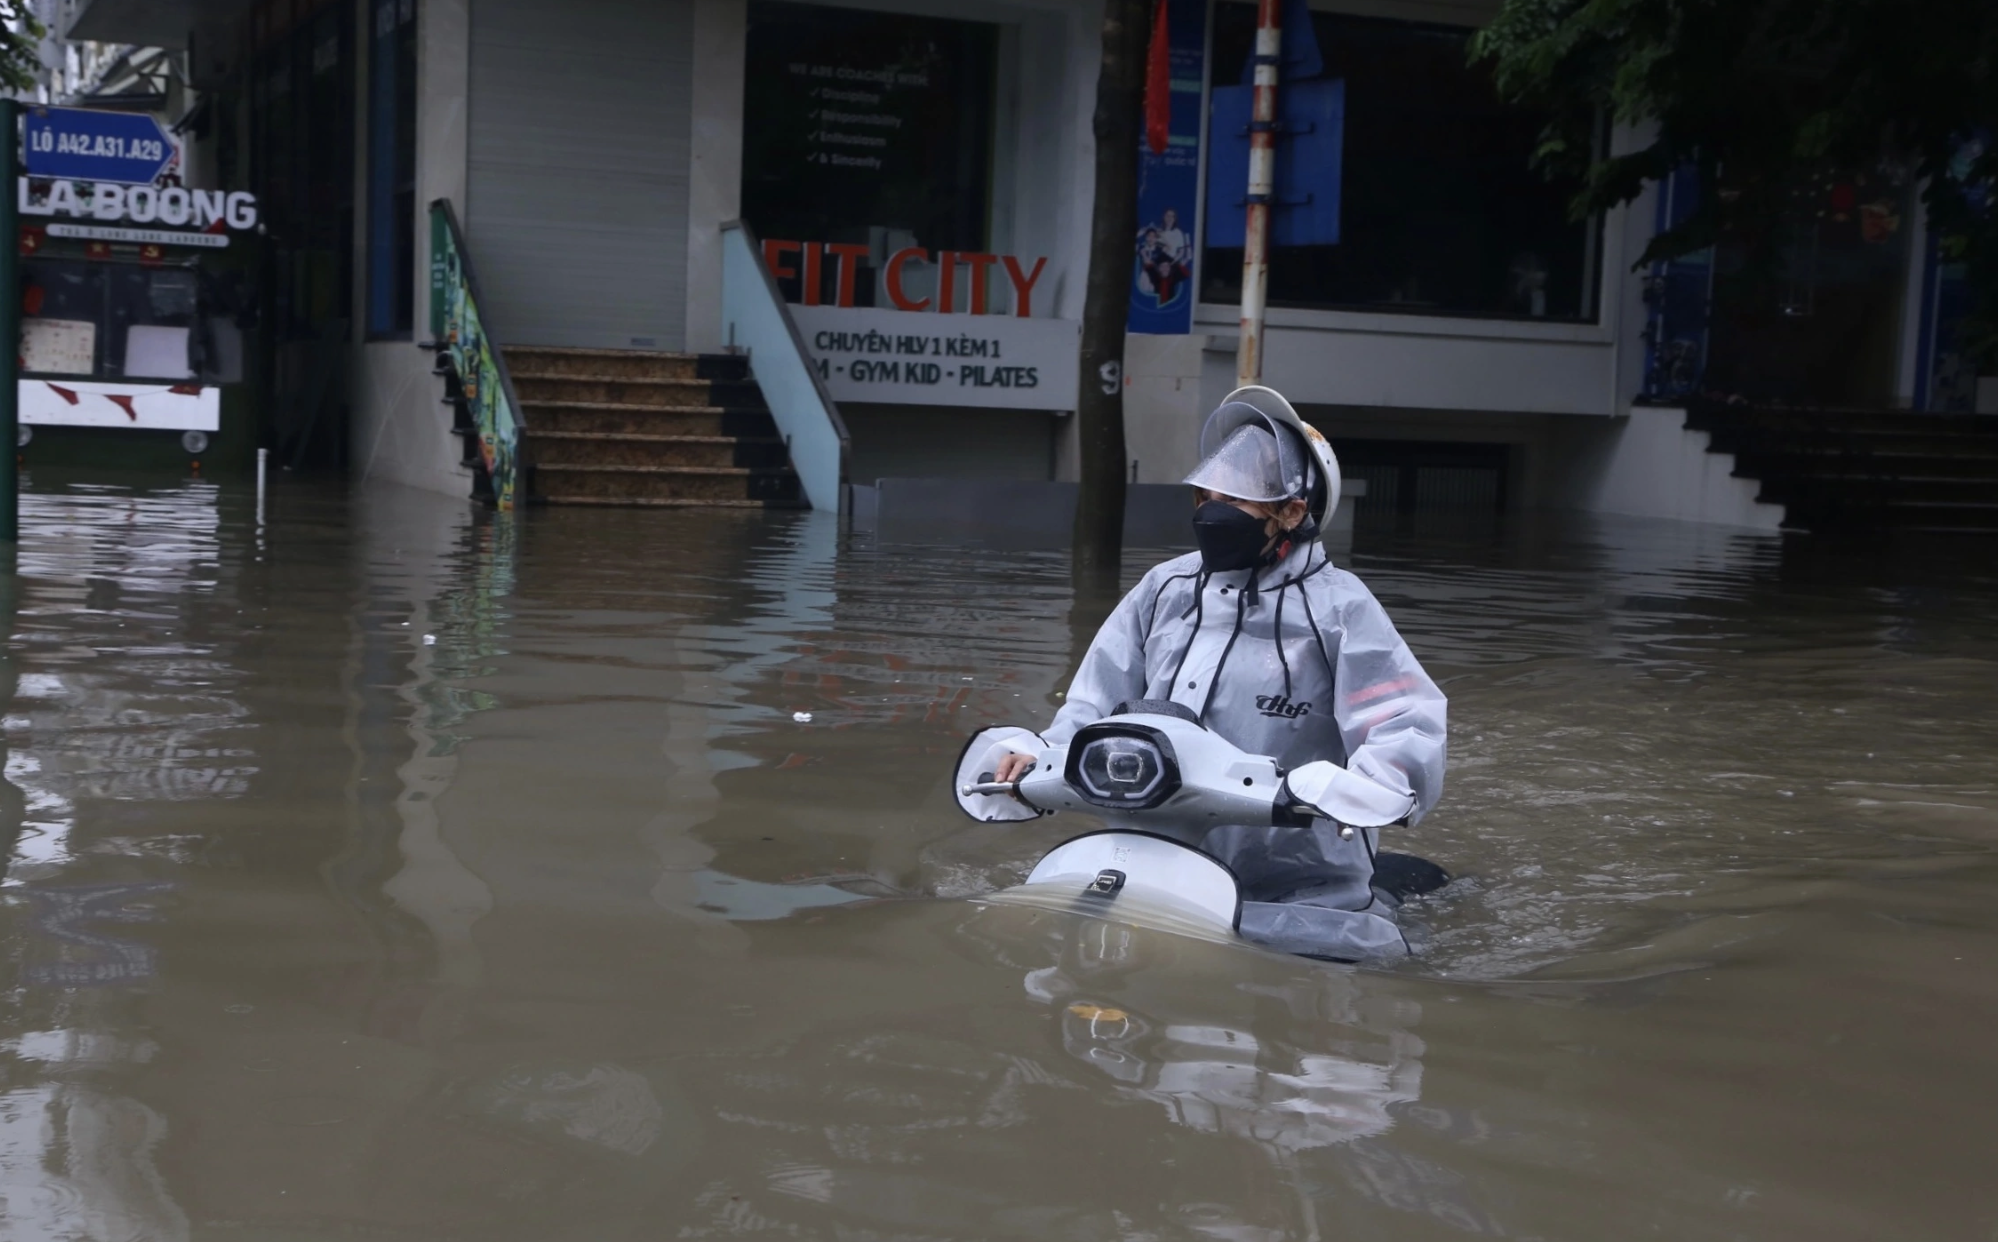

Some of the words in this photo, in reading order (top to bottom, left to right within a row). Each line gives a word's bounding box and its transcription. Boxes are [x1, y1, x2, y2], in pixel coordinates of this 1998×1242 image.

[31, 127, 53, 153] LÔ
[57, 133, 163, 161] A42.A31.A29
[820, 131, 887, 147] Enthusiasm
[761, 238, 869, 308] FIT
[883, 246, 1047, 318] CITY
[815, 328, 892, 354] CHUYÊN
[896, 335, 928, 357] HLV
[931, 337, 941, 357] 1
[945, 333, 987, 358] KÈM
[990, 340, 1000, 359] 1
[850, 360, 898, 383] GYM
[906, 363, 941, 385] KID
[960, 365, 1037, 388] PILATES
